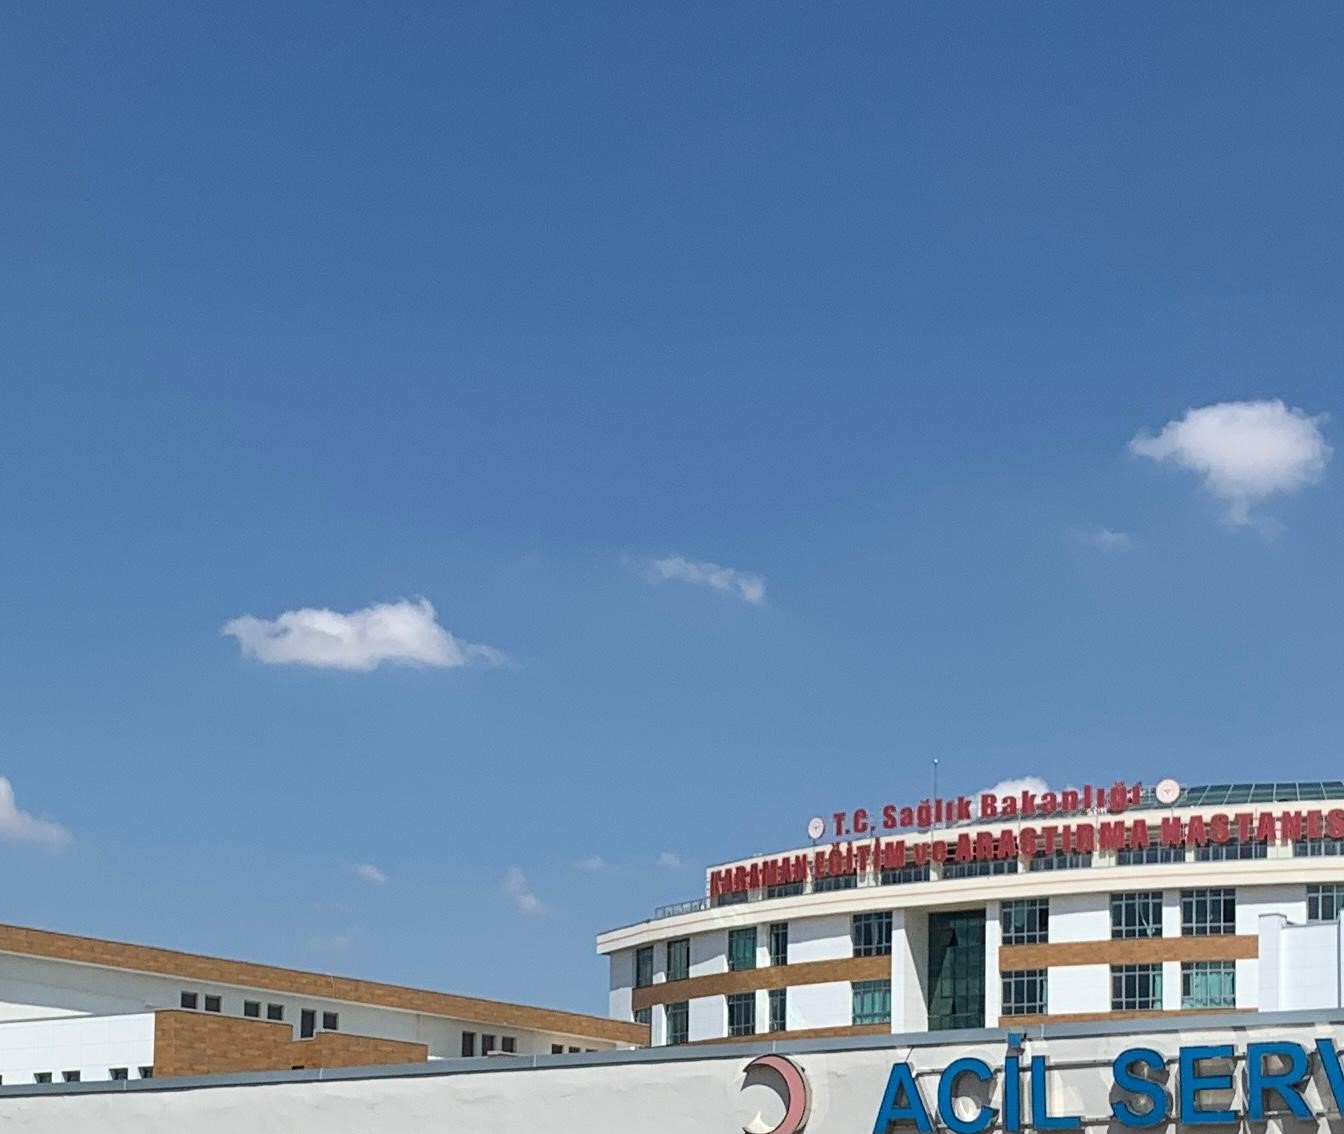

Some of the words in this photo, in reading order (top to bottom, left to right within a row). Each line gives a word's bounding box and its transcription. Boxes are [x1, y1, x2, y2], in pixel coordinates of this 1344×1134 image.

[883, 797, 973, 830] Sağlık
[979, 780, 1144, 817] Bakanlığı
[710, 854, 808, 897] KARAMAN
[813, 837, 907, 879] EĞİTİM
[913, 841, 947, 864] ve
